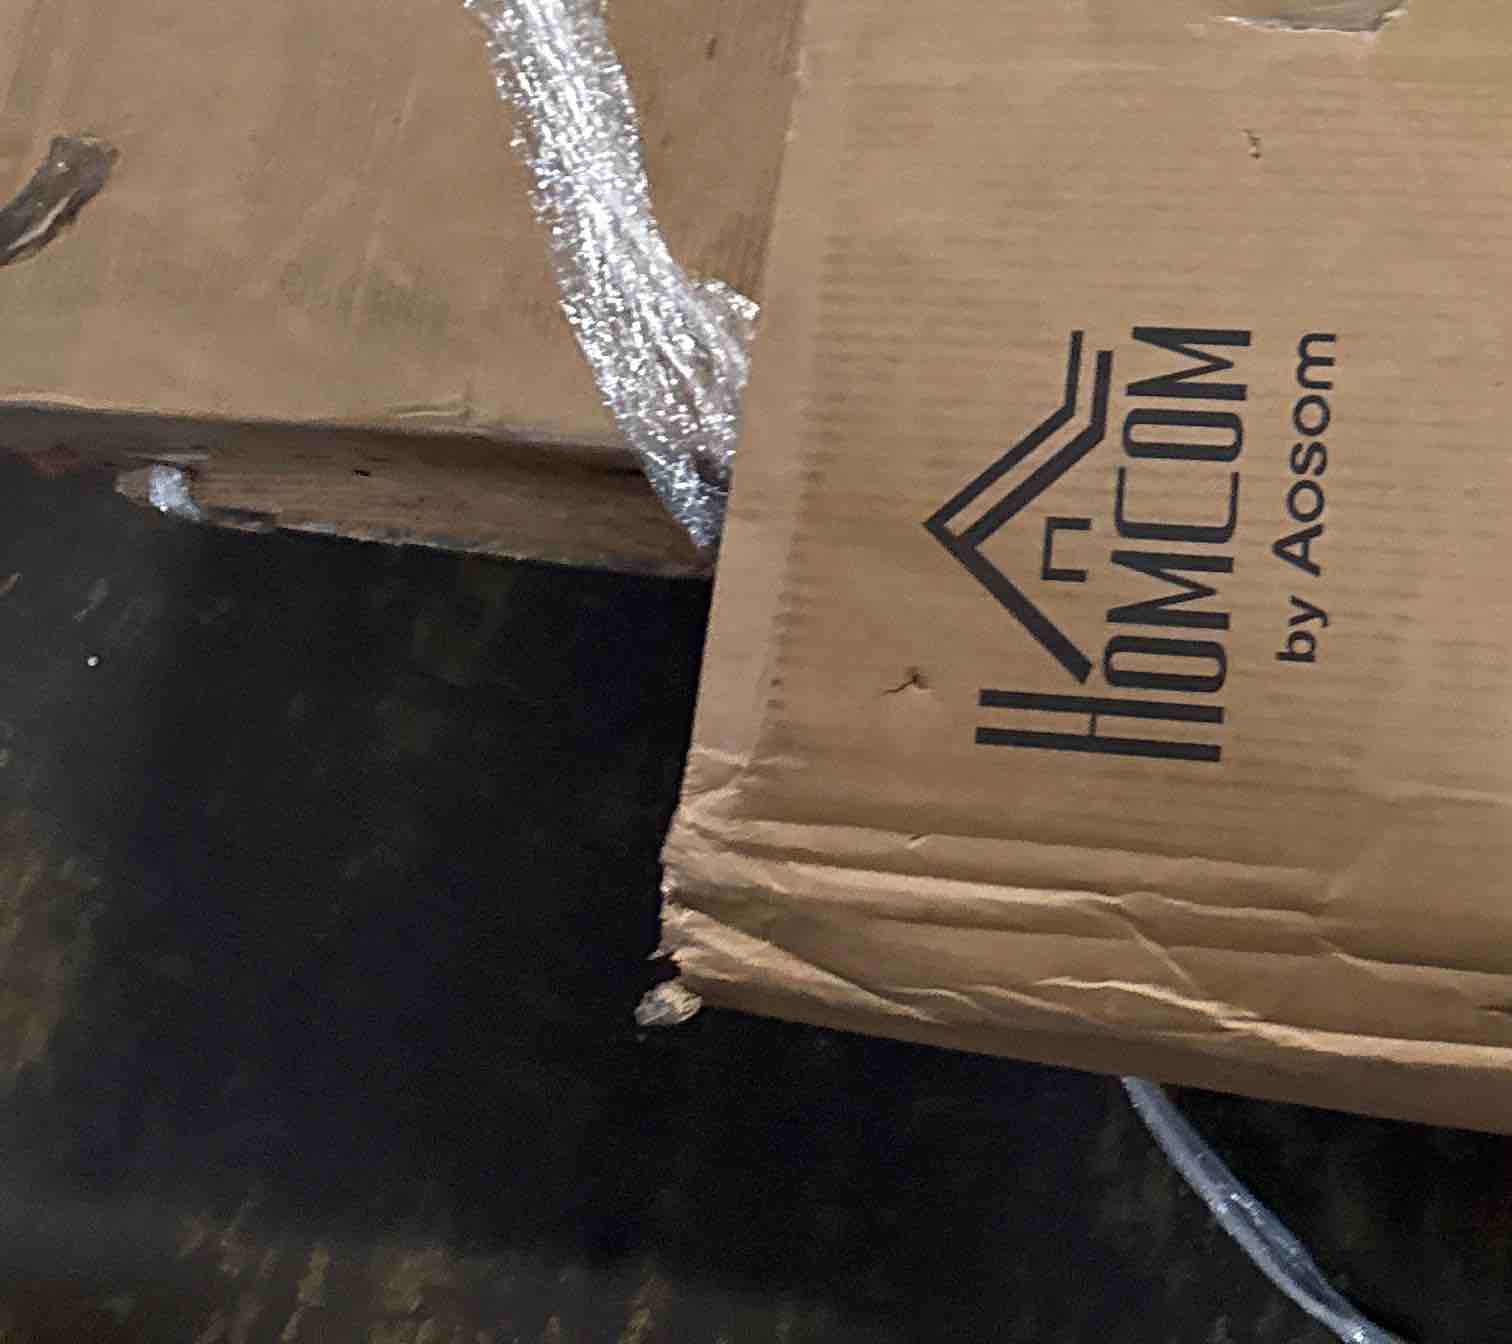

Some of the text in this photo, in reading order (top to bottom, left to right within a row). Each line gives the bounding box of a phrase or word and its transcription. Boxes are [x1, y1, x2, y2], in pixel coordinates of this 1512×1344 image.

[974, 325, 1252, 762] HOMCOM
[1271, 331, 1337, 663] by Aosom
